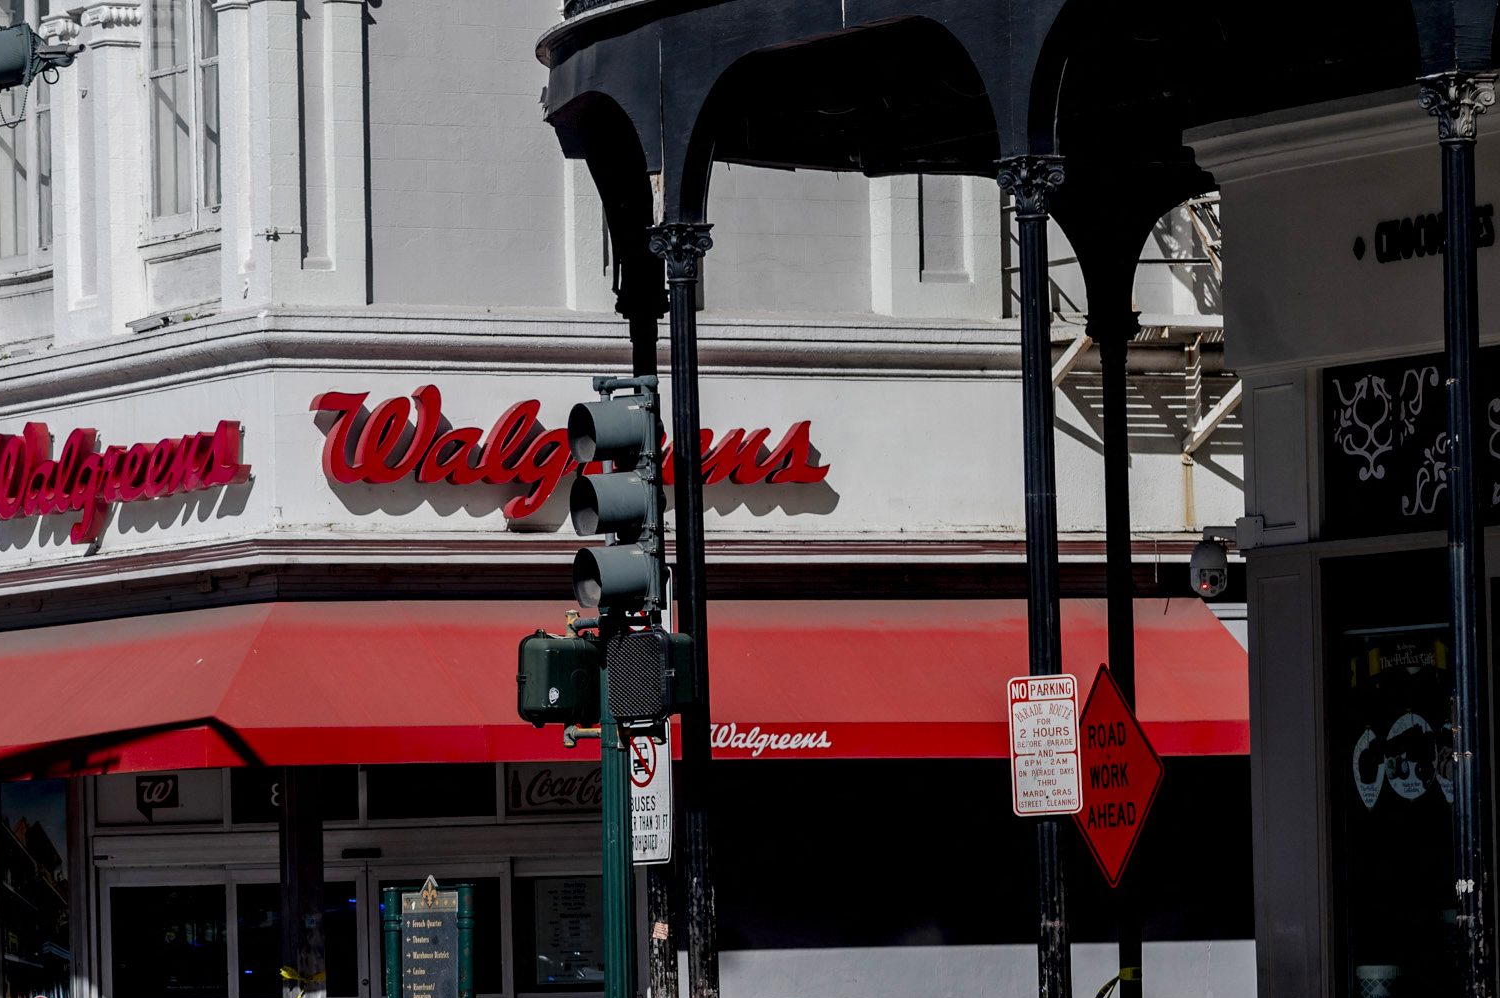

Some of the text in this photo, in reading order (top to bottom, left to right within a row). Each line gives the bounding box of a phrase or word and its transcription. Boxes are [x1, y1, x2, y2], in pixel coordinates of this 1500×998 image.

[309, 384, 831, 520] Walgns
[1011, 682, 1071, 700] NO PARKING
[1014, 703, 1074, 723] PARADE ROUTE
[710, 722, 832, 757] Walgreens
[1019, 726, 1070, 739] 2 HOURS
[1088, 722, 1126, 749] ROAD
[1017, 738, 1073, 749] BEFORE PARADE
[1037, 750, 1054, 758] AND
[1050, 758, 1068, 766] 2AM
[1031, 769, 1055, 777] PARADE
[1059, 767, 1075, 775] DAYS
[1089, 762, 1130, 790] WORK
[526, 767, 602, 807] Coca-C
[1022, 788, 1072, 798] MARDI GRAS
[639, 815, 653, 831] THAN
[655, 814, 661, 831] 31
[663, 813, 669, 830] FT
[1087, 802, 1136, 829] AHEAD
[412, 920, 442, 928] French Quarter
[412, 951, 449, 959] Warehouse District
[412, 967, 426, 975] Casino
